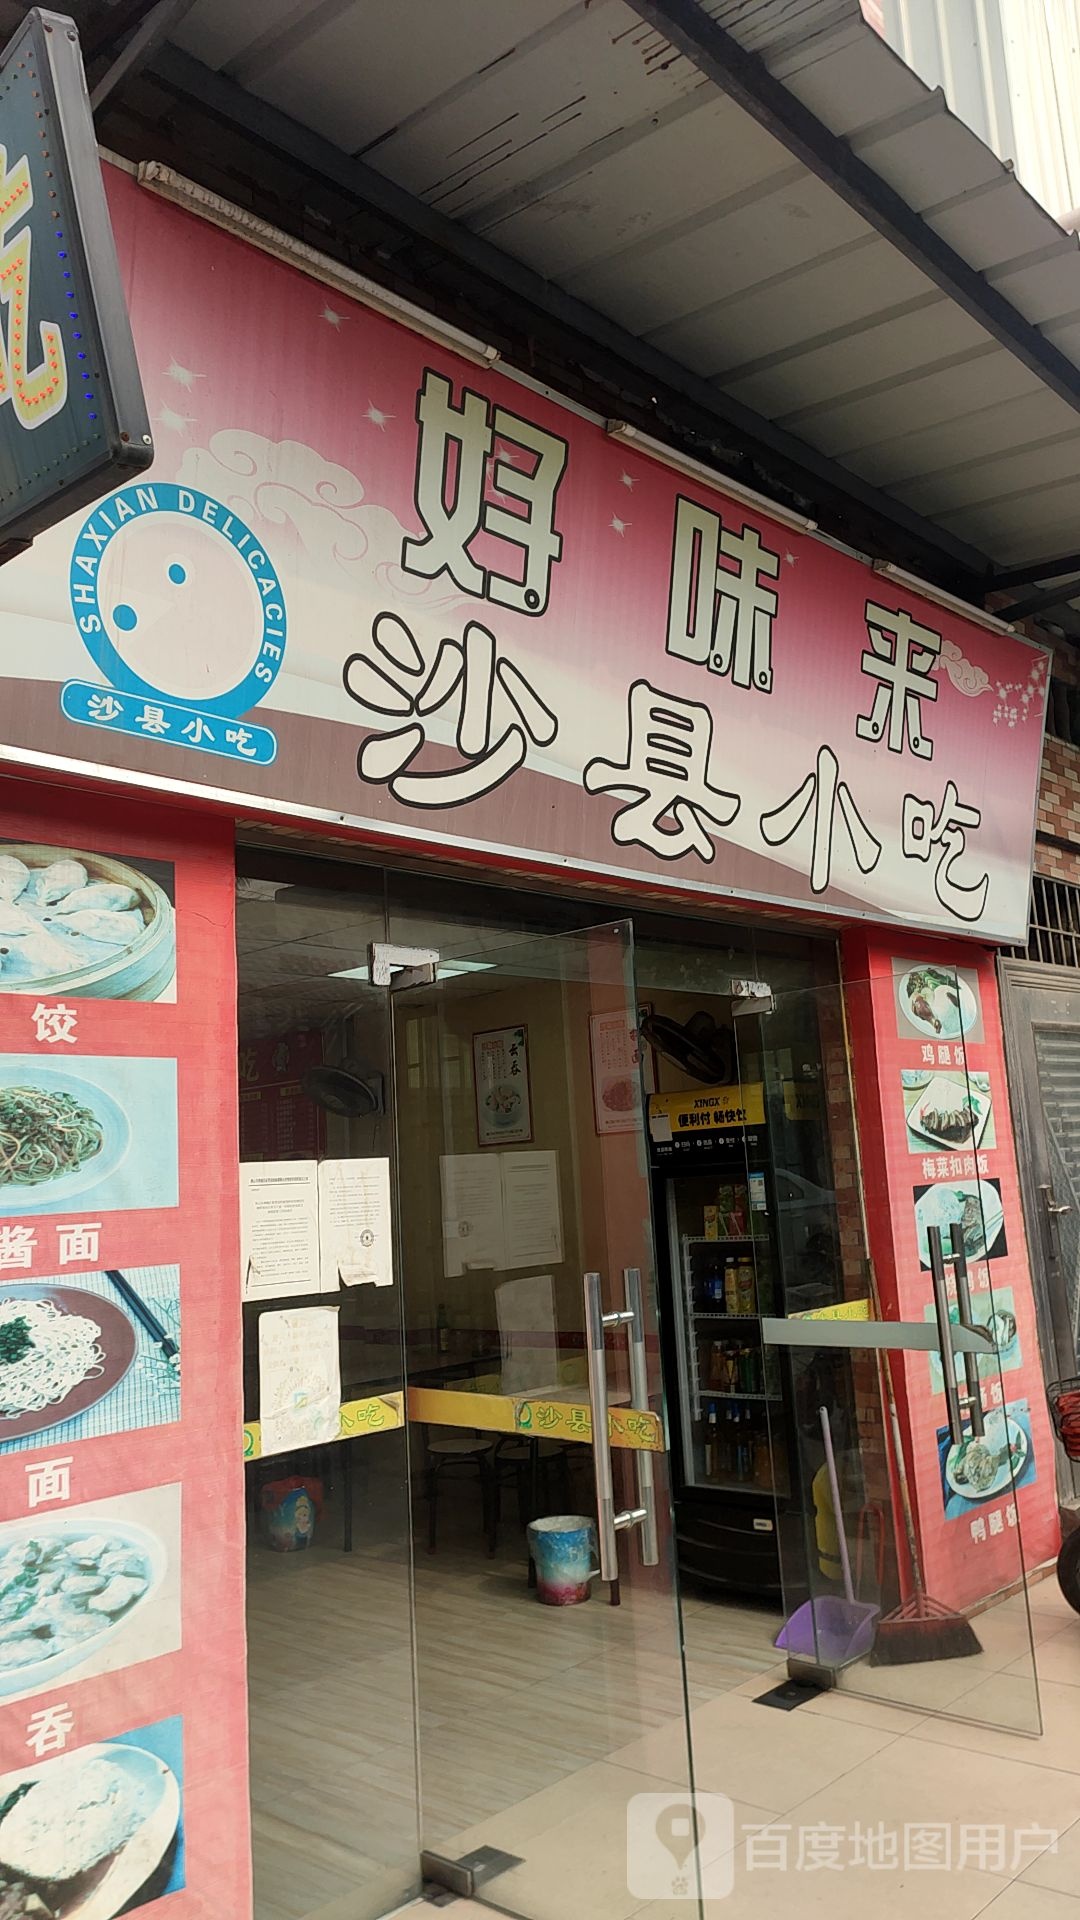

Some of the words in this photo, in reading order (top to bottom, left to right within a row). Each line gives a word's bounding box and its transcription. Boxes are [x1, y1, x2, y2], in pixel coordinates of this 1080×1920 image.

[74, 487, 158, 633] SHAXIAN
[178, 490, 283, 683] DELICACIES
[402, 367, 942, 760] 好味来
[87, 694, 257, 757] 沙县小吃
[343, 611, 988, 921] 沙县小吃
[31, 1003, 78, 1044] 饺
[921, 1044, 965, 1065] 鸡腿饭
[678, 1111, 710, 1127] 便利付
[922, 1154, 989, 1179] 梅菜扣肉饭
[24, 1456, 73, 1508] 面
[25, 1703, 73, 1757] 吞
